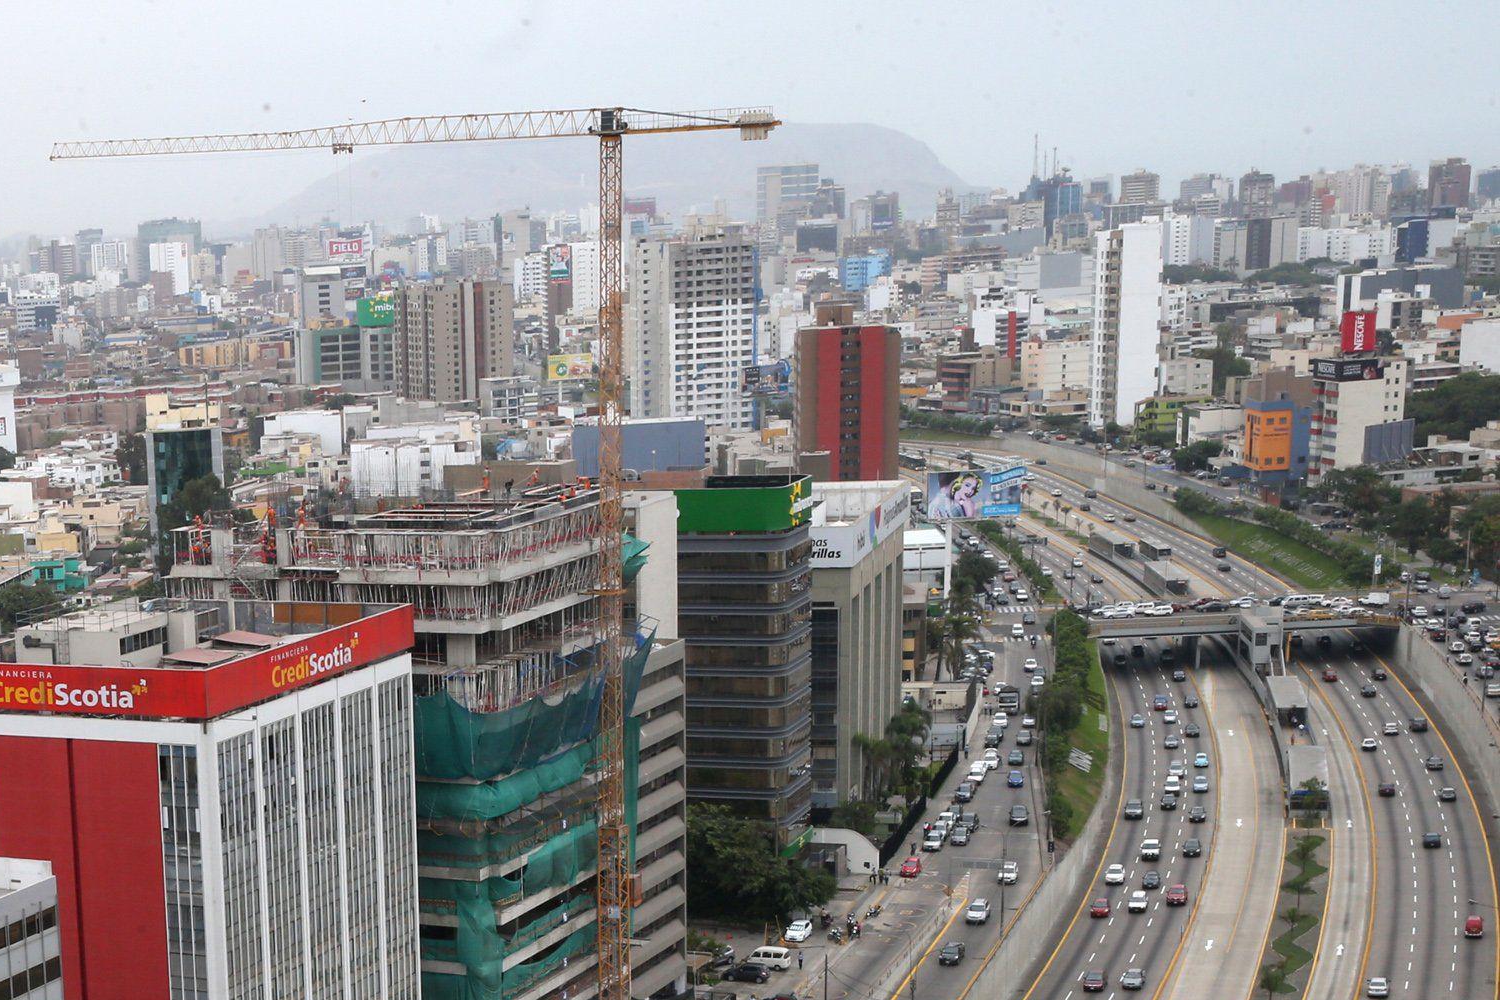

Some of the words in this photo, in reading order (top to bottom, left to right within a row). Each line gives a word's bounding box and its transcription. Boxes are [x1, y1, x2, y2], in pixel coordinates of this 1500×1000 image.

[332, 242, 359, 253] FIELD
[270, 645, 309, 663] FINANCIERA
[271, 643, 352, 688] CrediScotia
